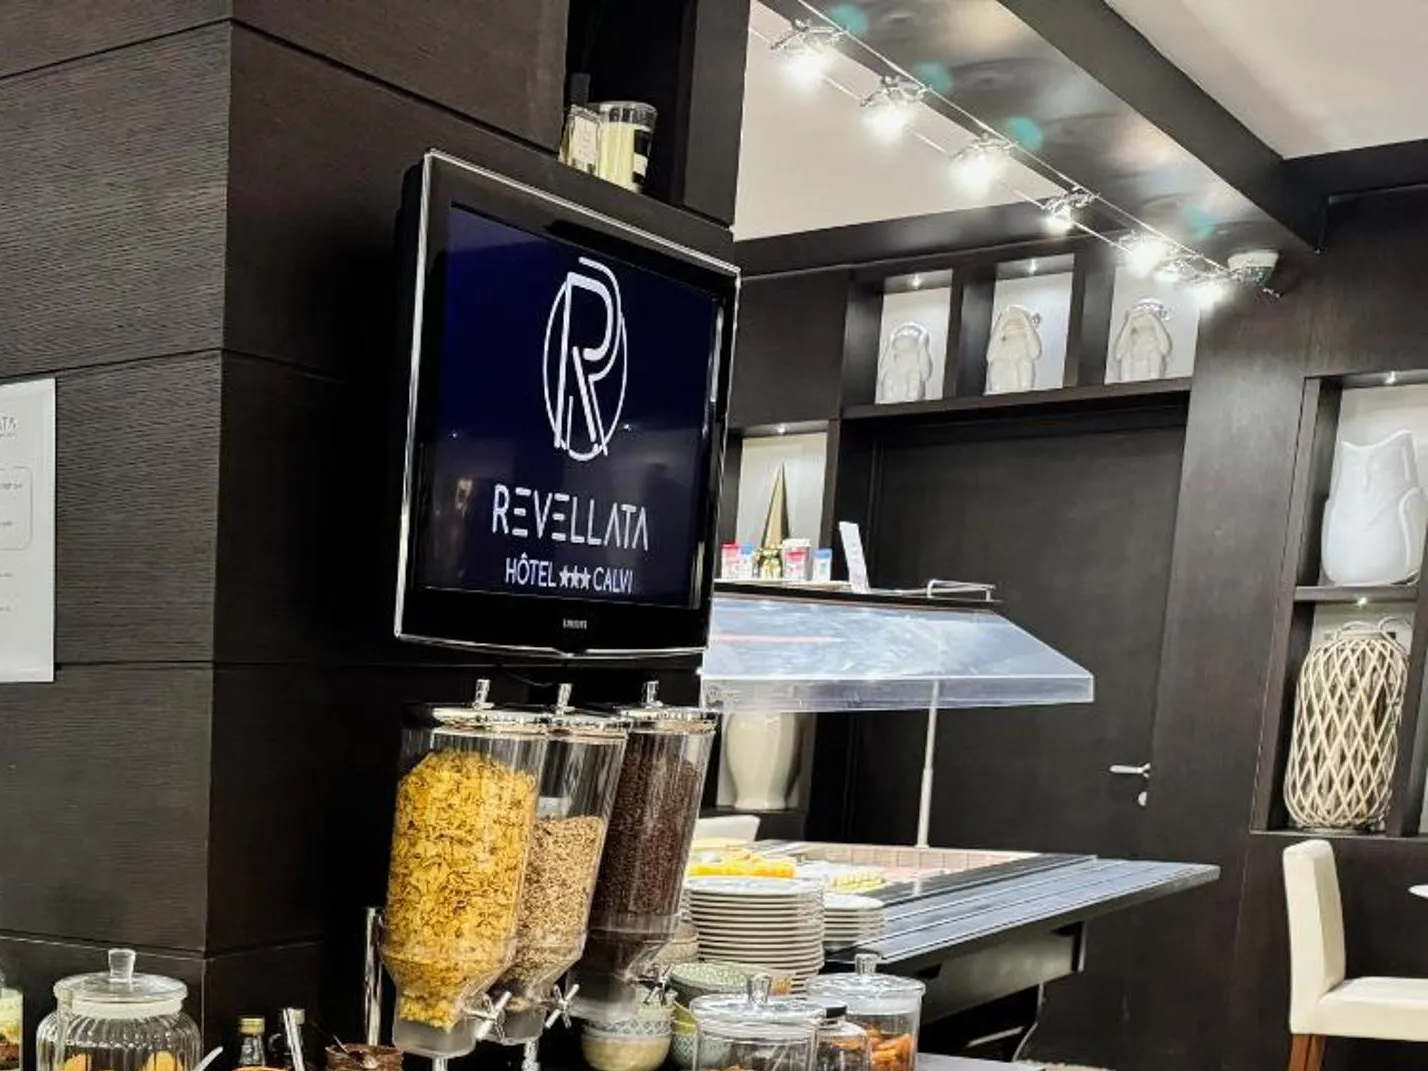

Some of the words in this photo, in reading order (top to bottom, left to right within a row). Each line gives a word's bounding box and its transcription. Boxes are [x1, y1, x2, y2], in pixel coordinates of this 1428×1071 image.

[492, 483, 649, 551] REVELLATA
[505, 552, 557, 588] HÔTEL
[593, 567, 633, 594] CALVI
